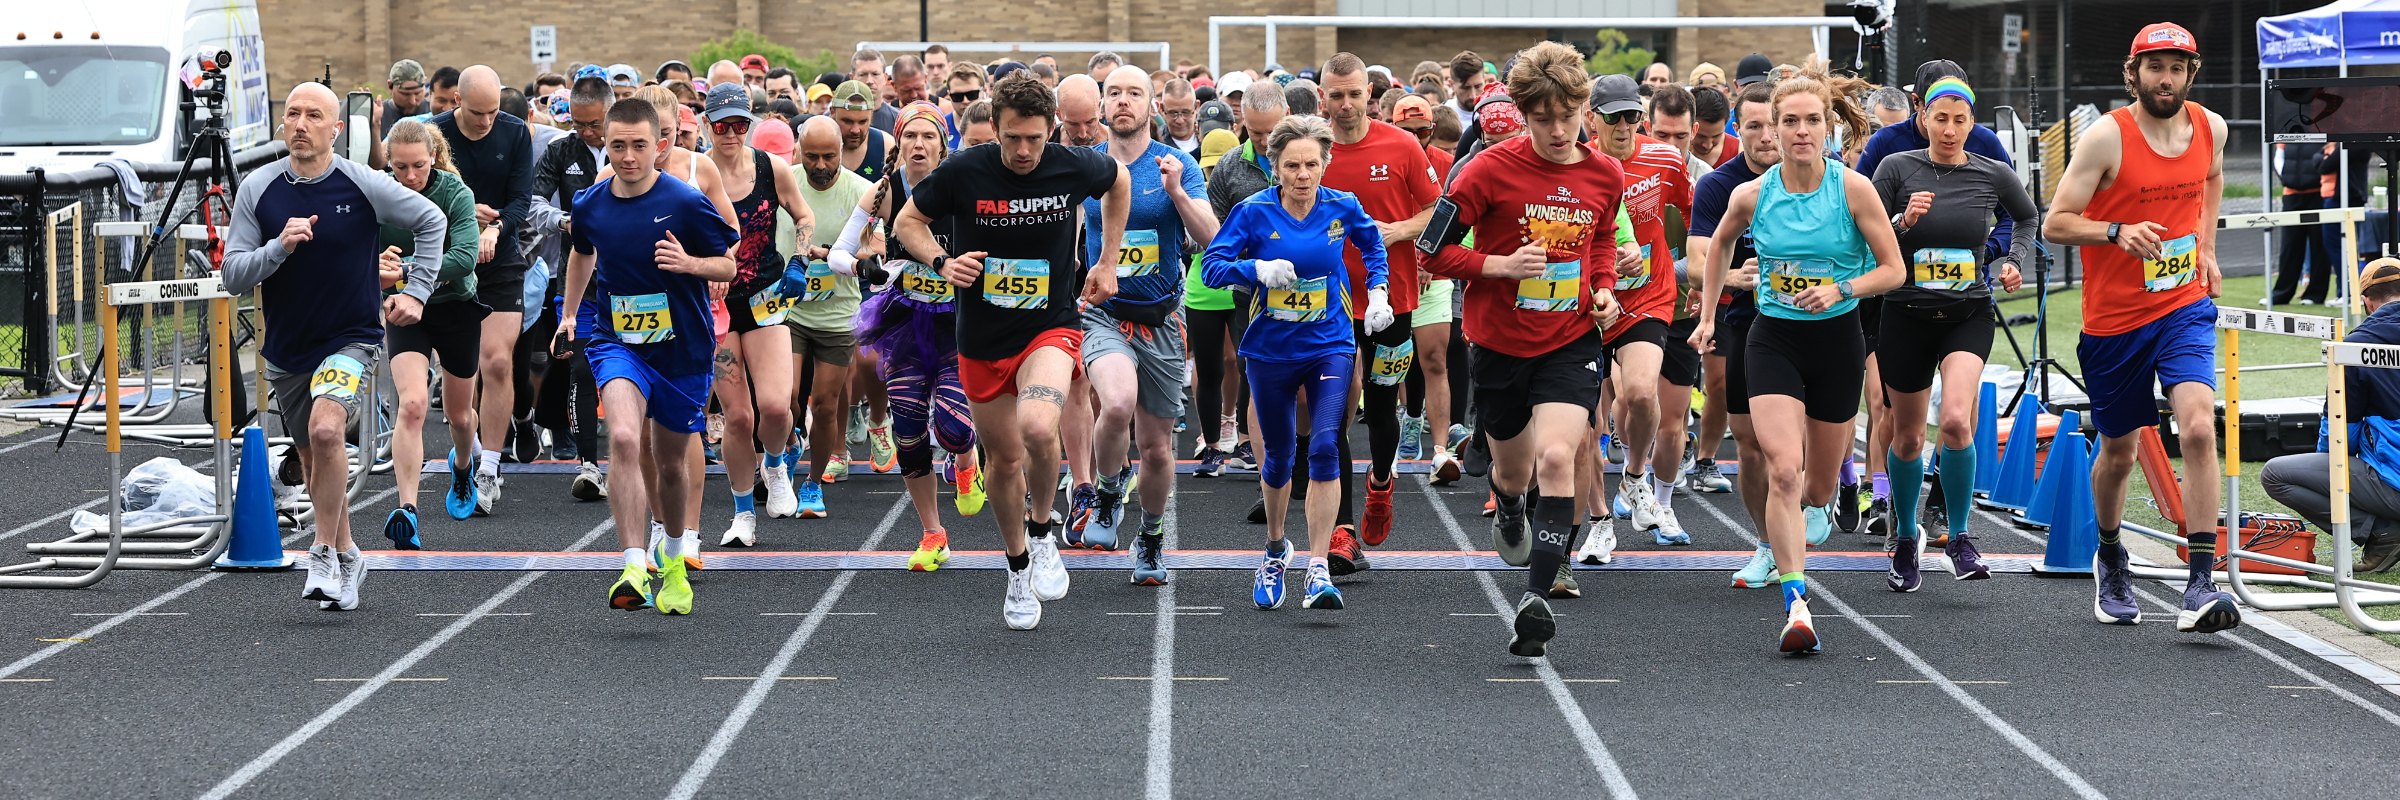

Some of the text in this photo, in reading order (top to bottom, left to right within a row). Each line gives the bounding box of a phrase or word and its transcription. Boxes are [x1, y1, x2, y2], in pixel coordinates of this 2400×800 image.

[1546, 195, 1581, 204] STORFLEX
[975, 210, 1071, 227] INCORPORATED
[1525, 203, 1593, 225] WINEGLASS
[1119, 248, 1143, 264] 70
[1927, 264, 1963, 280] 134
[2155, 253, 2191, 278] 284
[160, 282, 199, 298] CORNING
[912, 277, 948, 294] 253
[994, 277, 1038, 295] 455
[1549, 281, 1557, 298] 1
[1283, 292, 1312, 309] 44
[621, 312, 660, 331] 273
[1381, 355, 1410, 375] 369
[2361, 347, 2400, 367] CORNI
[314, 368, 351, 387] 203
